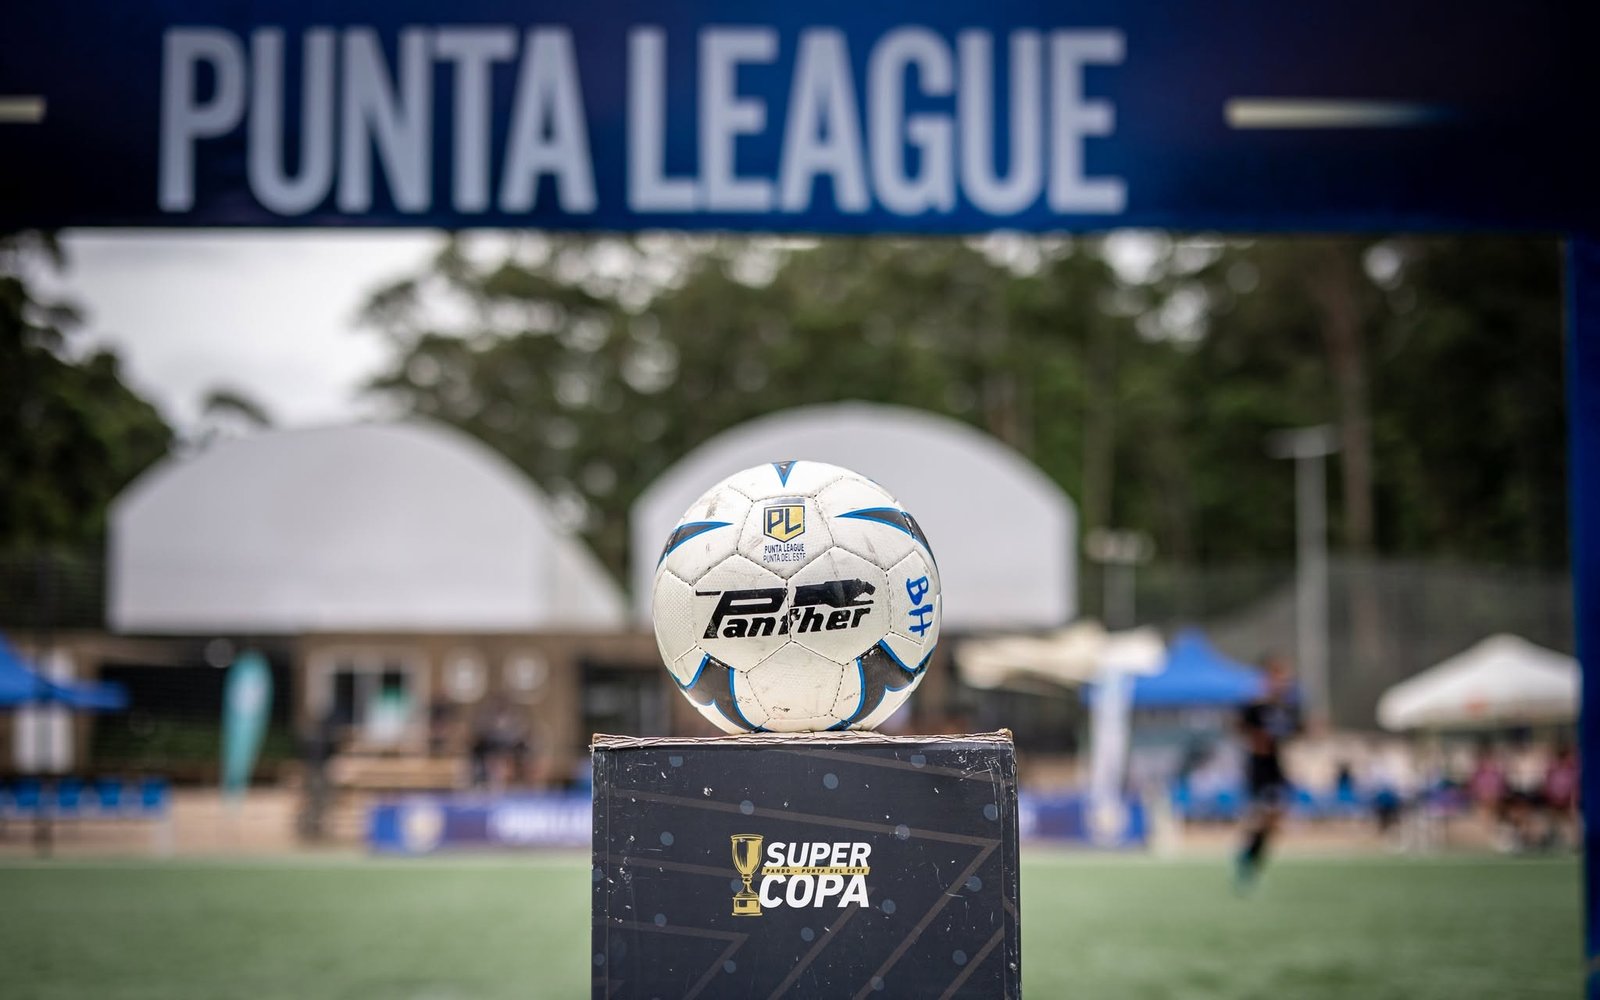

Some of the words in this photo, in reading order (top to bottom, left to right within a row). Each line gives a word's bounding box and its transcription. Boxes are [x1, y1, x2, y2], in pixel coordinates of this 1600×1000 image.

[158, 27, 597, 214] PUNTA
[627, 26, 1127, 215] LEAGUE
[767, 508, 801, 535] PL
[763, 554, 781, 563] PUNTA
[781, 553, 791, 561] DEL
[764, 544, 782, 554] PUNTA
[783, 543, 805, 552] LEAGUE
[695, 587, 871, 640] Panther
[905, 576, 933, 637] BH
[764, 842, 872, 867] SUPER
[759, 874, 870, 908] COPA
